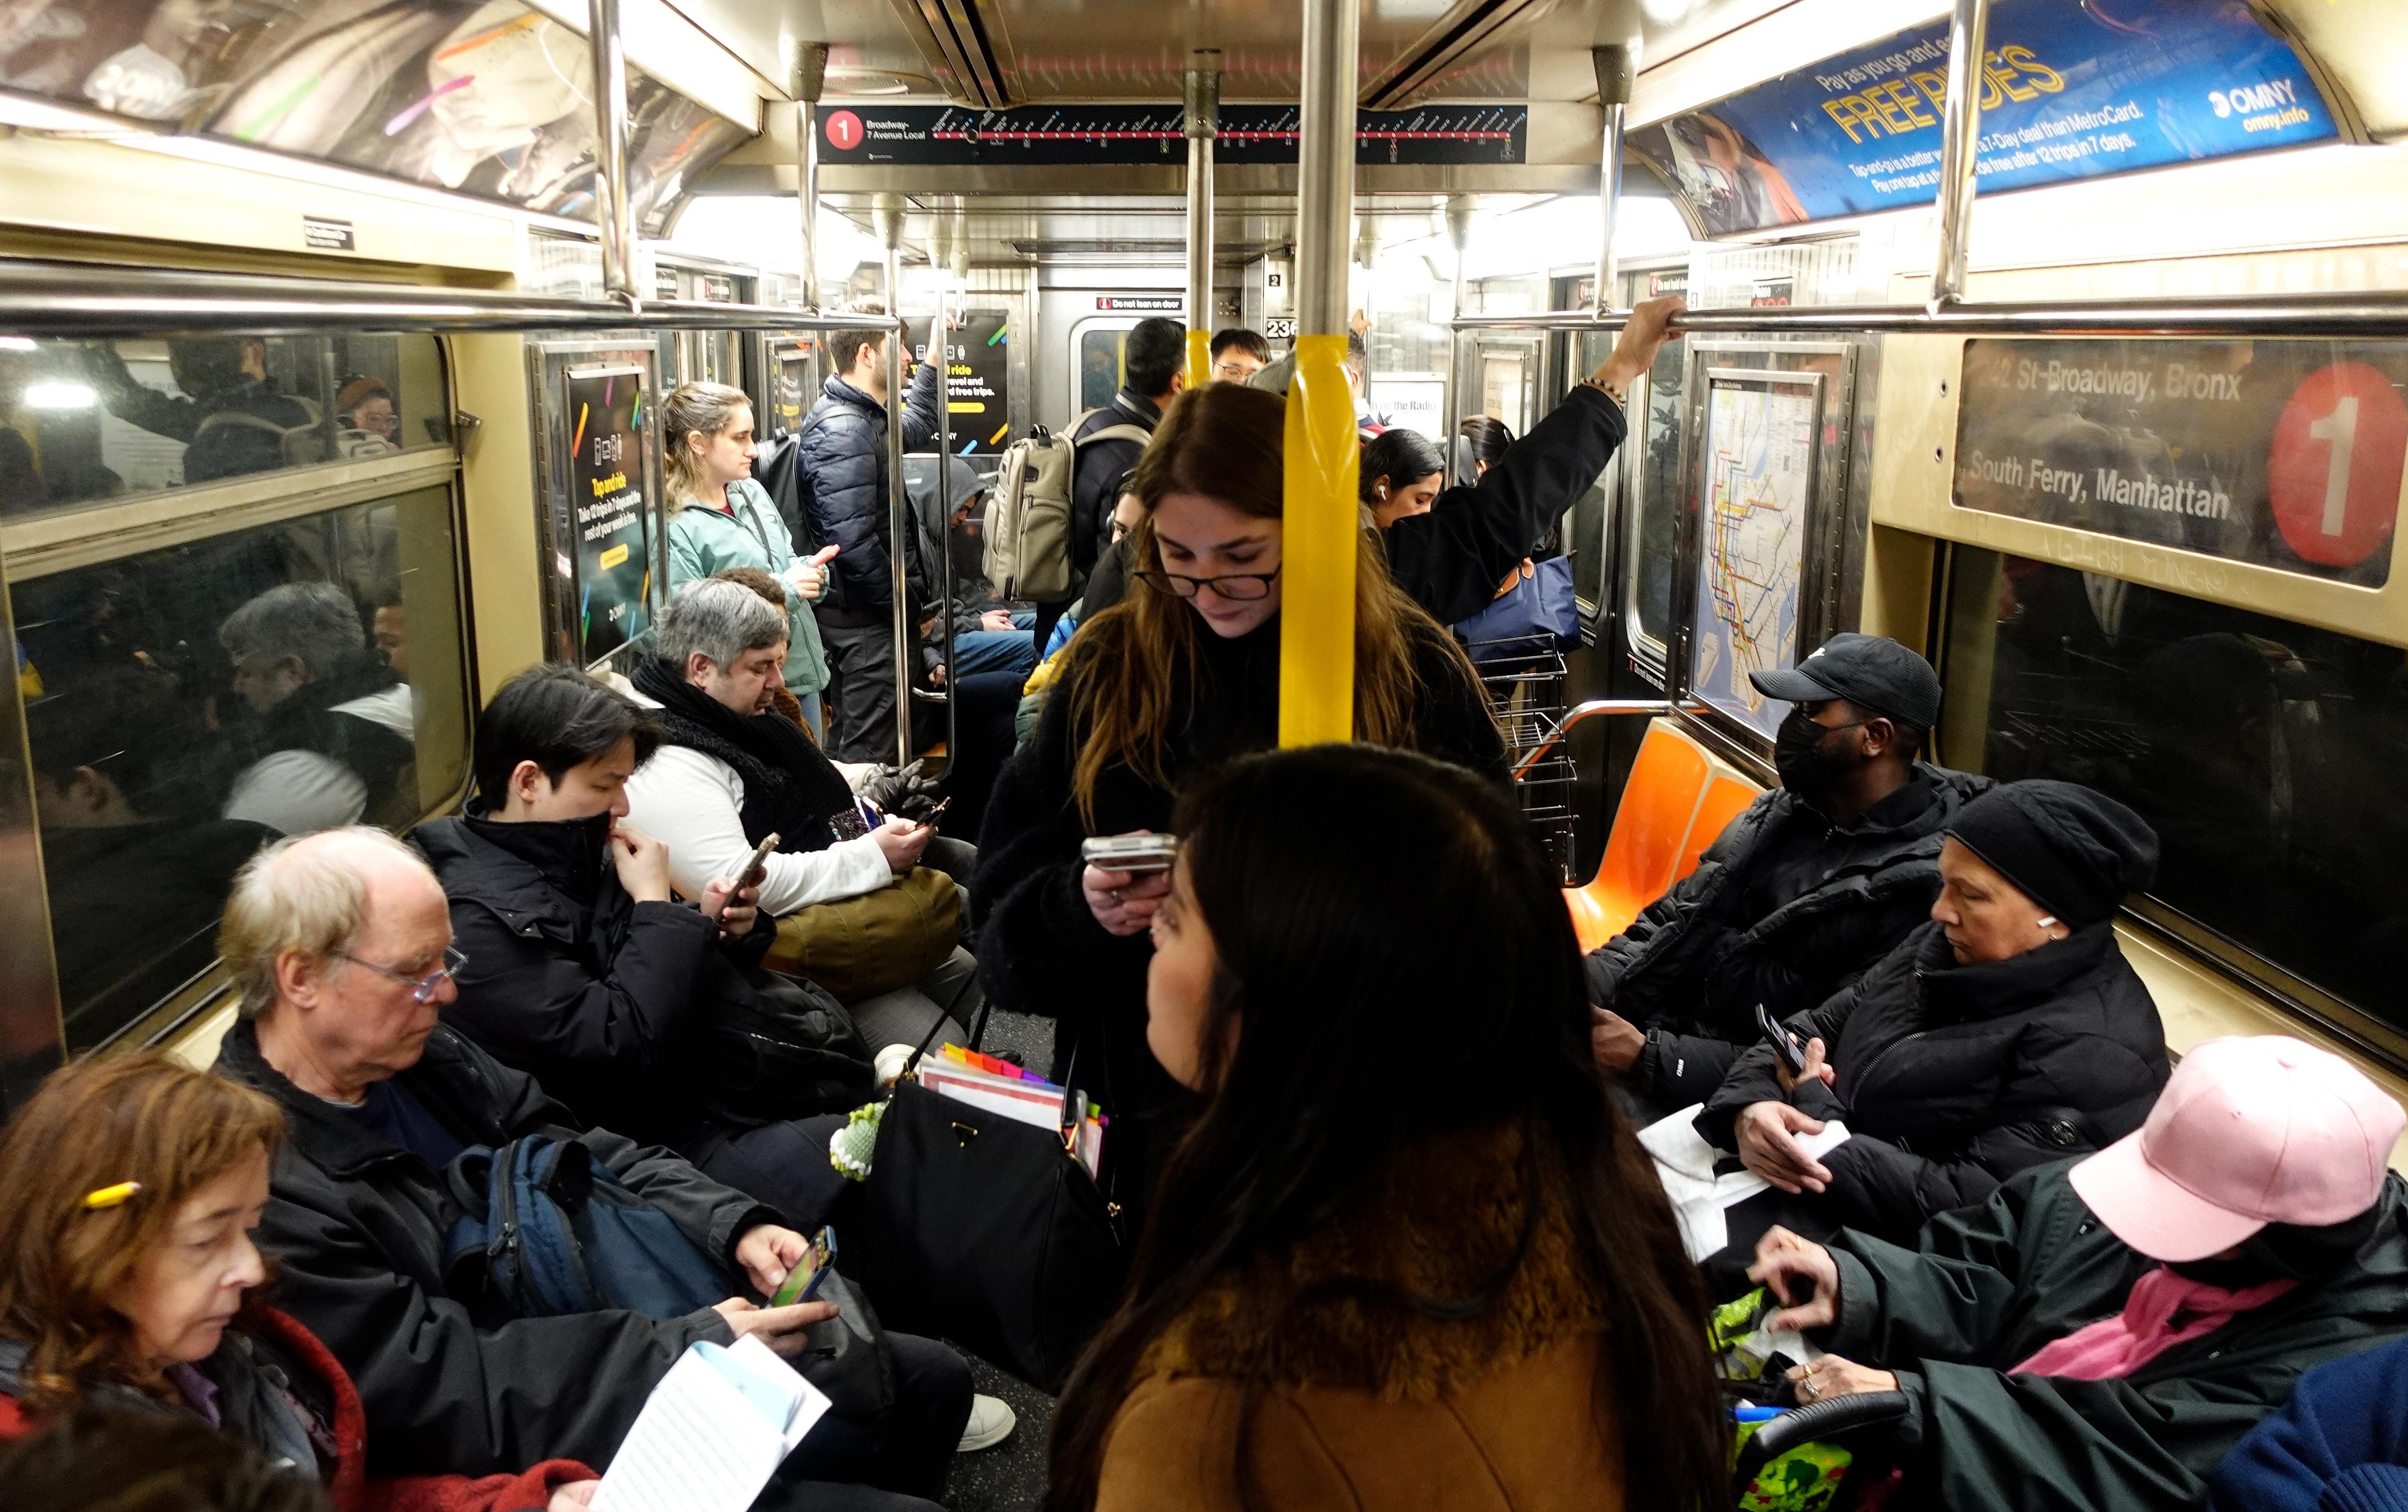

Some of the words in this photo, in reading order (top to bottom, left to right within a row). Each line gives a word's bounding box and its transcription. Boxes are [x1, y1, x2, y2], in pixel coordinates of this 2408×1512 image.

[1815, 75, 1851, 92] Pay
[1844, 67, 1867, 84] as
[1860, 59, 1893, 81] you
[1885, 53, 1912, 72] go
[1906, 38, 1942, 63] and
[1822, 79, 1937, 144] FREE
[1909, 45, 2066, 118] RDES
[2229, 78, 2296, 114] OMNY
[866, 120, 910, 131] Broadway-
[2066, 100, 2144, 133] MetroCard.
[2243, 105, 2309, 133] omny.info
[838, 119, 848, 141] 1
[866, 131, 872, 140] 7
[873, 131, 903, 140] Avenue
[903, 131, 926, 140] Local
[2017, 123, 2045, 144] deal
[2040, 119, 2071, 139] than
[1982, 140, 1989, 153] a
[1983, 133, 2020, 151] 7-Day
[1975, 160, 1992, 175] ide
[1988, 155, 2014, 172] free
[2011, 150, 2039, 168] after
[2036, 146, 2054, 163] 12
[2049, 143, 2080, 162] trips
[2076, 139, 2093, 156] in
[2087, 135, 2099, 154] 7
[2099, 132, 2136, 153] days.
[1848, 158, 1895, 179] Tap-and-go
[1904, 150, 1935, 168] better
[1871, 179, 1892, 194] Pay
[1889, 179, 1903, 191] one
[1901, 175, 1919, 190] tap
[1917, 171, 1929, 186] at
[1271, 275, 1279, 286] 2
[1112, 299, 1124, 308] Do
[1124, 300, 1136, 308] not
[1136, 299, 1152, 308] lean
[1162, 300, 1180, 308] door
[951, 364, 972, 376] ride
[947, 377, 968, 386] ravel
[967, 377, 984, 386] and
[956, 387, 973, 397] free
[972, 387, 996, 397] trips.
[2166, 363, 2241, 401] Bronx
[1394, 401, 1408, 411] the
[1410, 401, 1436, 411] Radio
[934, 432, 958, 441] ONY
[2309, 396, 2359, 537] 1
[591, 478, 605, 499] Tap
[603, 473, 616, 494] and
[1970, 450, 2023, 488] South
[2028, 458, 2088, 505] Ferry,
[2095, 467, 2230, 521] Manhattan
